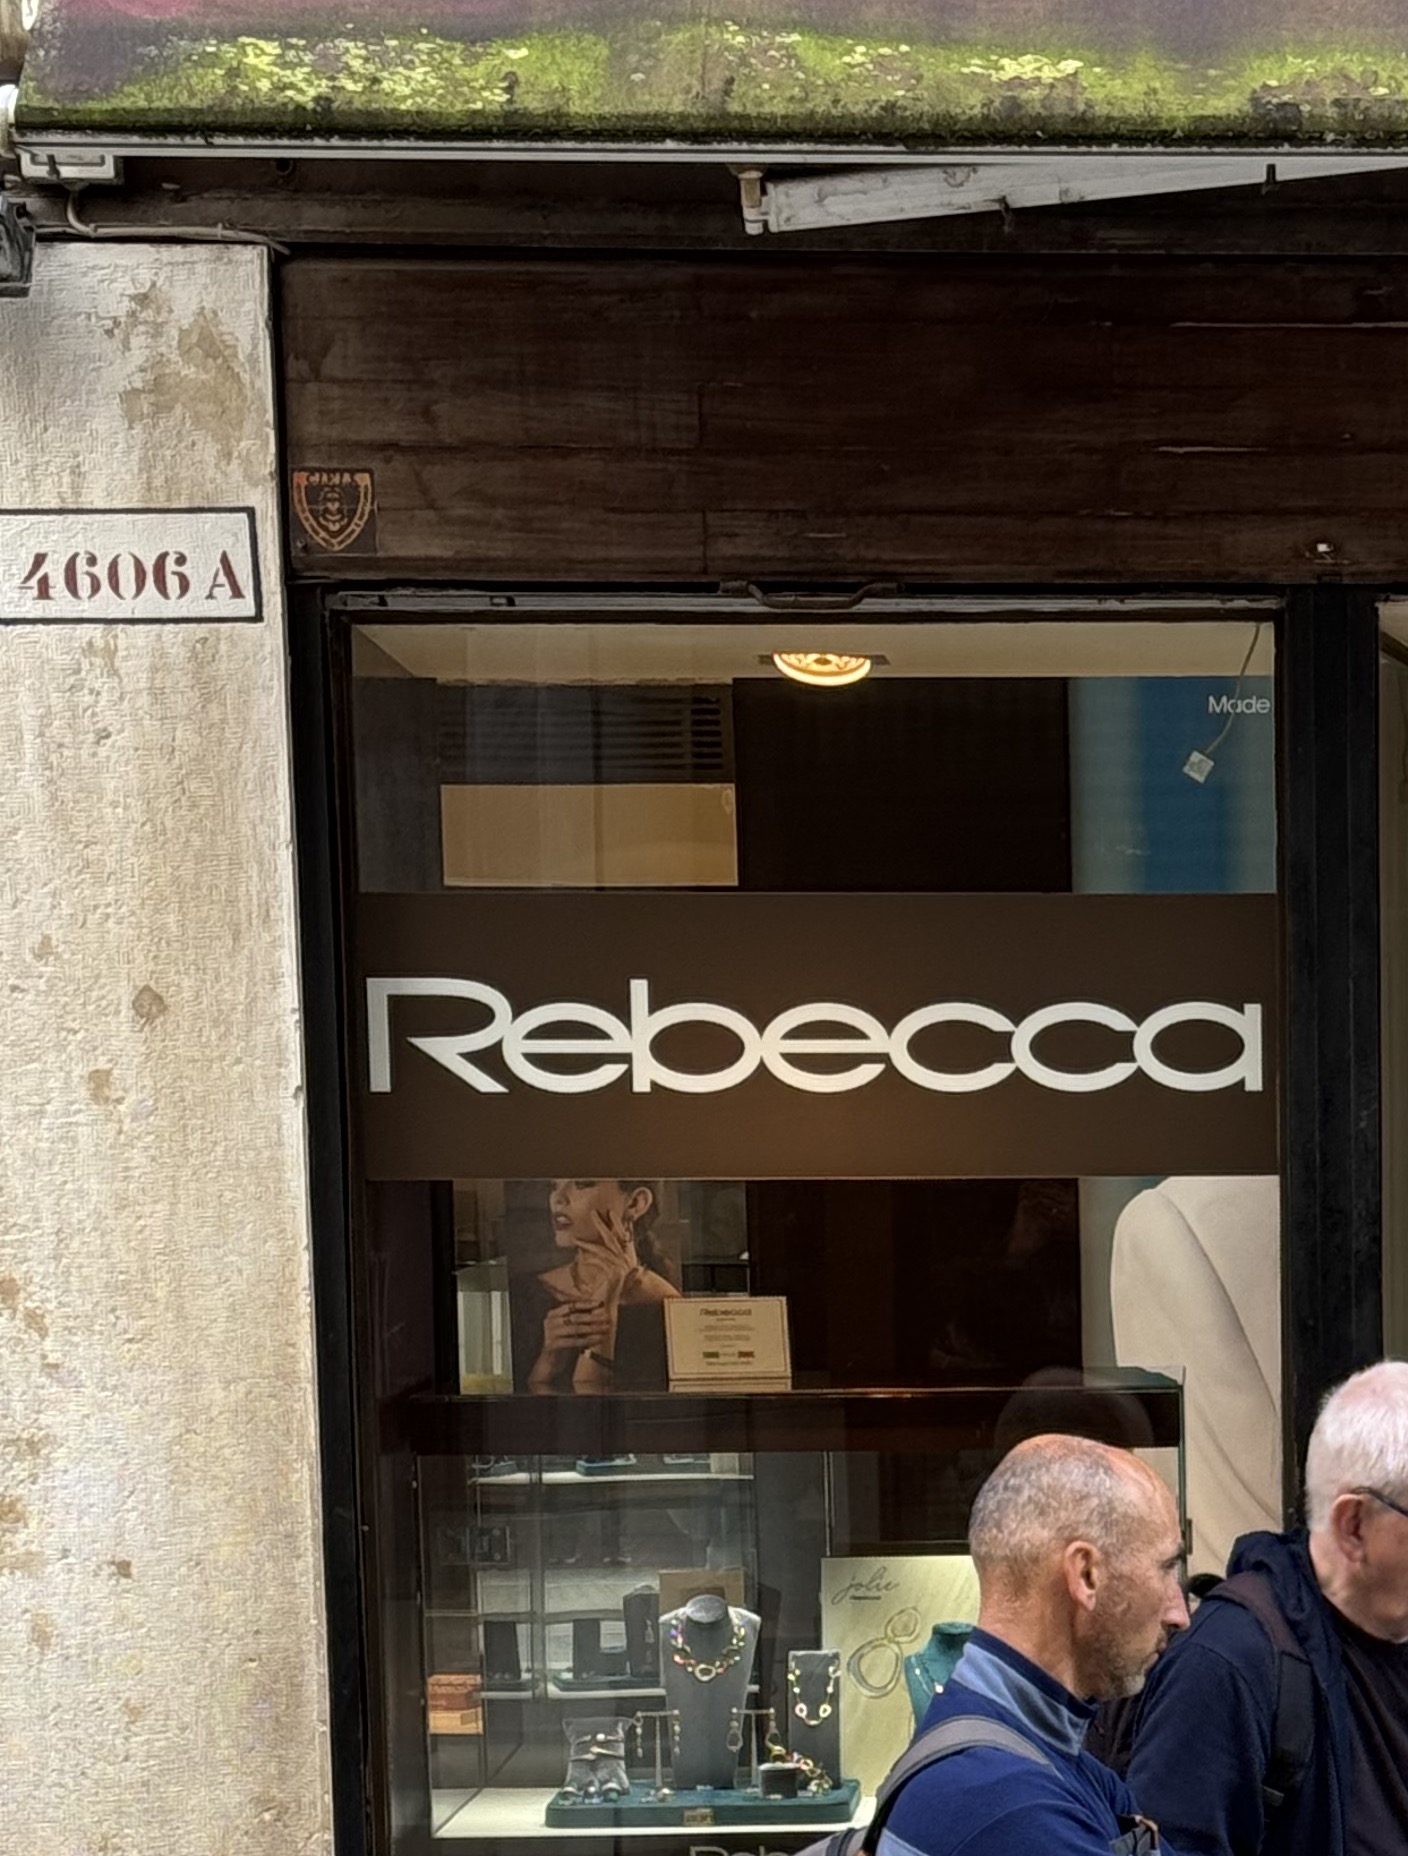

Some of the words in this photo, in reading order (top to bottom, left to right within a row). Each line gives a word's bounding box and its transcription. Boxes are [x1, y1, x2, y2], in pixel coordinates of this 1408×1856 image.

[17, 550, 191, 601] 4606
[204, 550, 247, 600] A
[1207, 694, 1271, 714] Made
[365, 976, 1264, 1094] Rebecca
